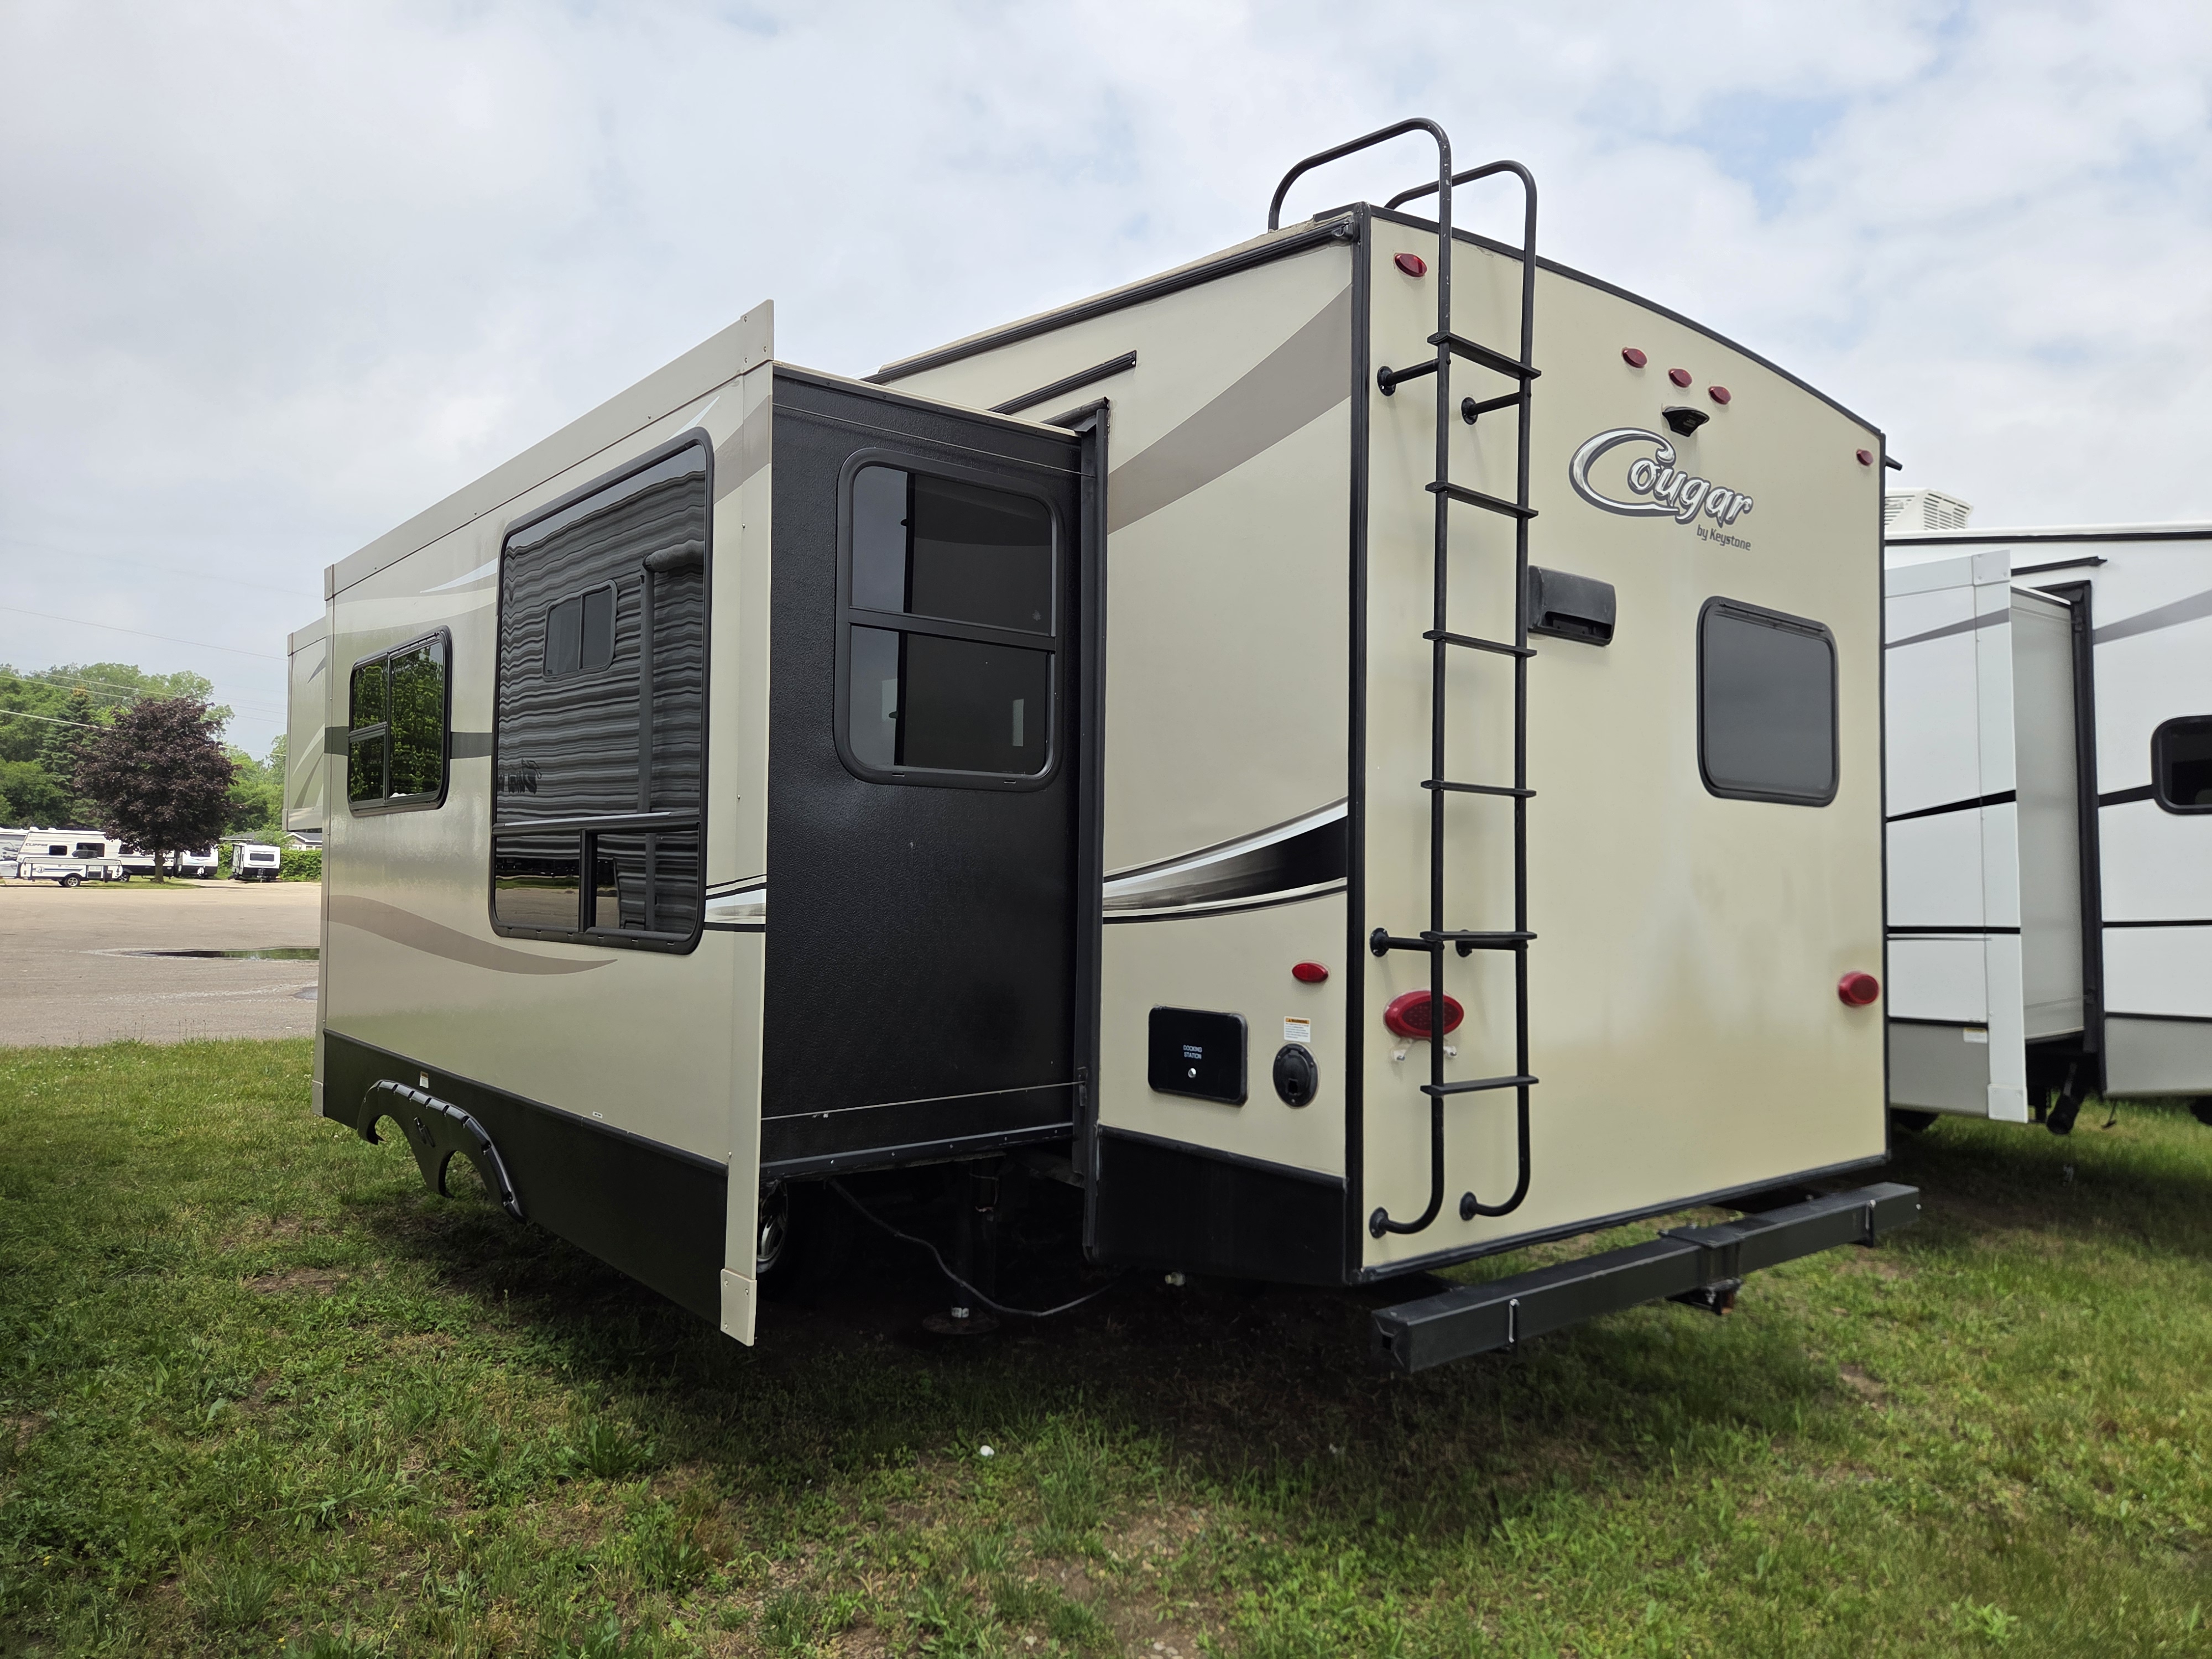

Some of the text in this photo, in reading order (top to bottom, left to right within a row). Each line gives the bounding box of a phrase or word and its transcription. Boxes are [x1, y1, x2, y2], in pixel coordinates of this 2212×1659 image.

[1569, 427, 1753, 528] Cougar
[1697, 524, 1751, 551] by Keystone
[1183, 1044, 1202, 1053] DOCKING
[1184, 1051, 1202, 1060] STATION
